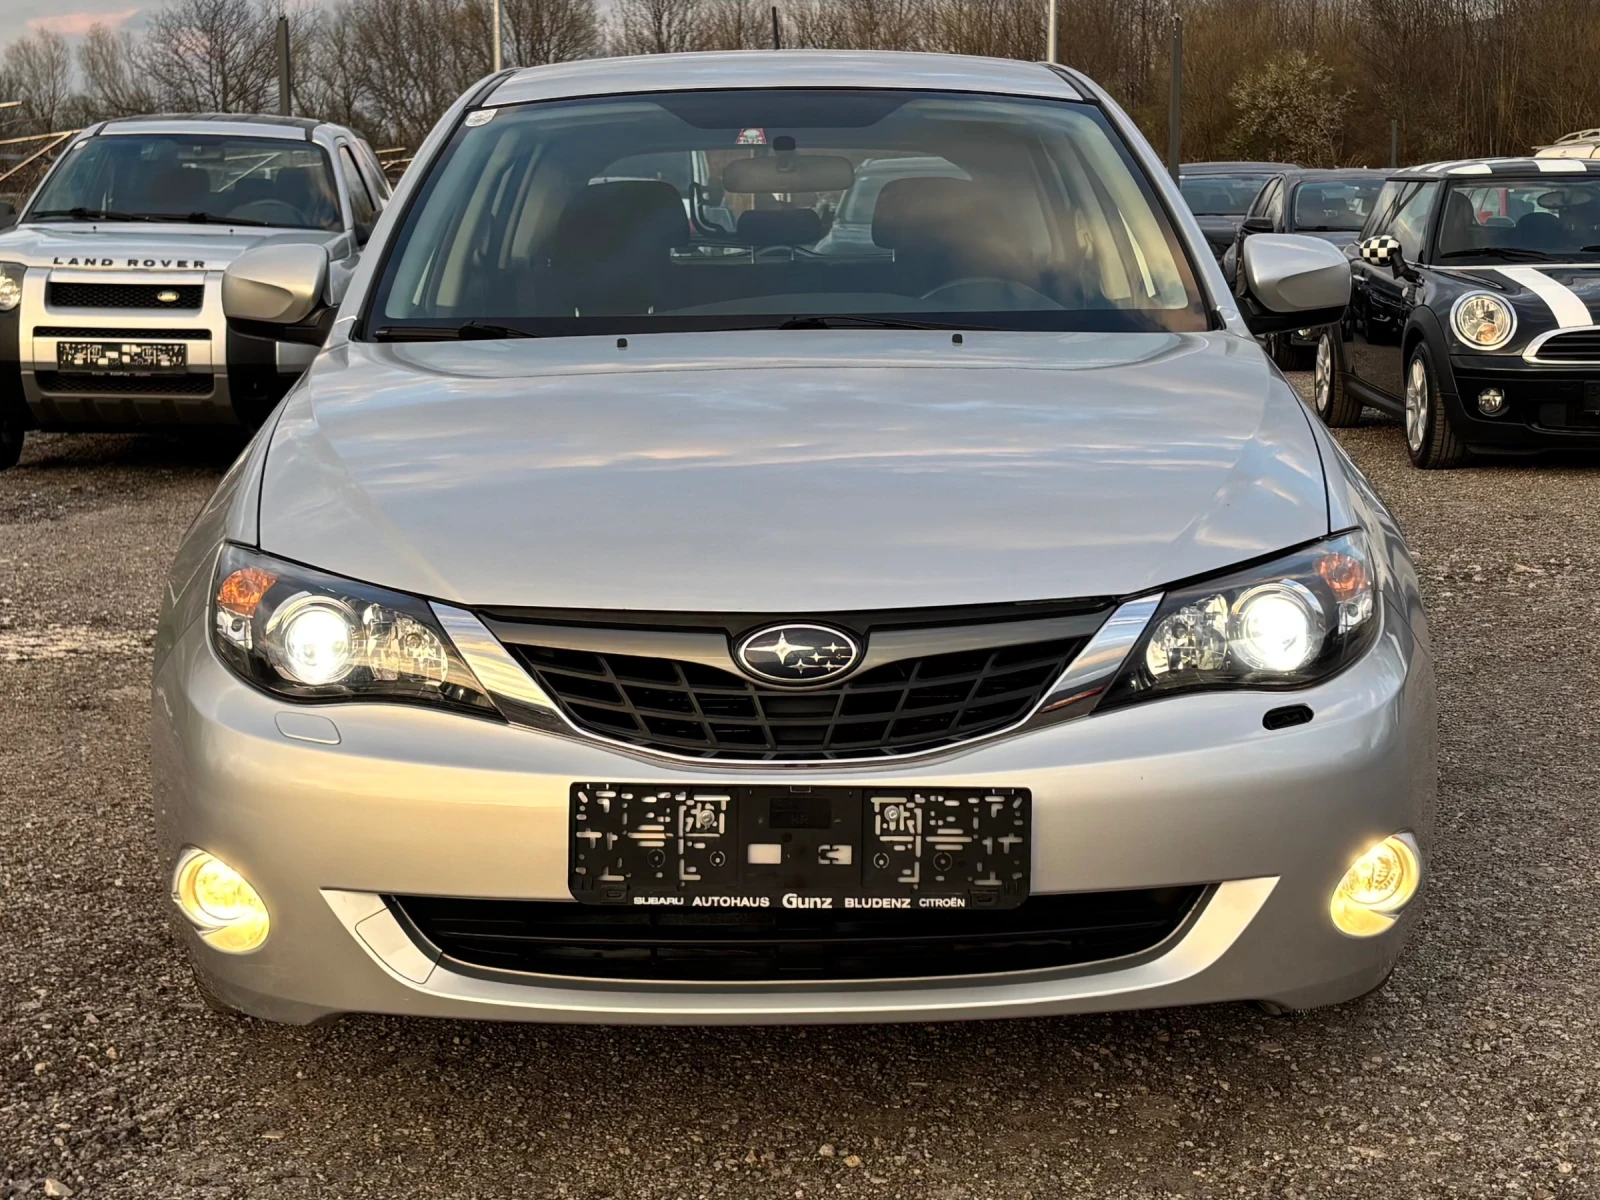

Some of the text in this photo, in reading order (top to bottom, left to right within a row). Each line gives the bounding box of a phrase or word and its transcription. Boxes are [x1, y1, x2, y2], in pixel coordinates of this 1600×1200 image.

[53, 256, 205, 269] LAND ROVER
[633, 892, 966, 909] SUBARU AUTOHAUS Gunz BLUDENZ CITROËN
